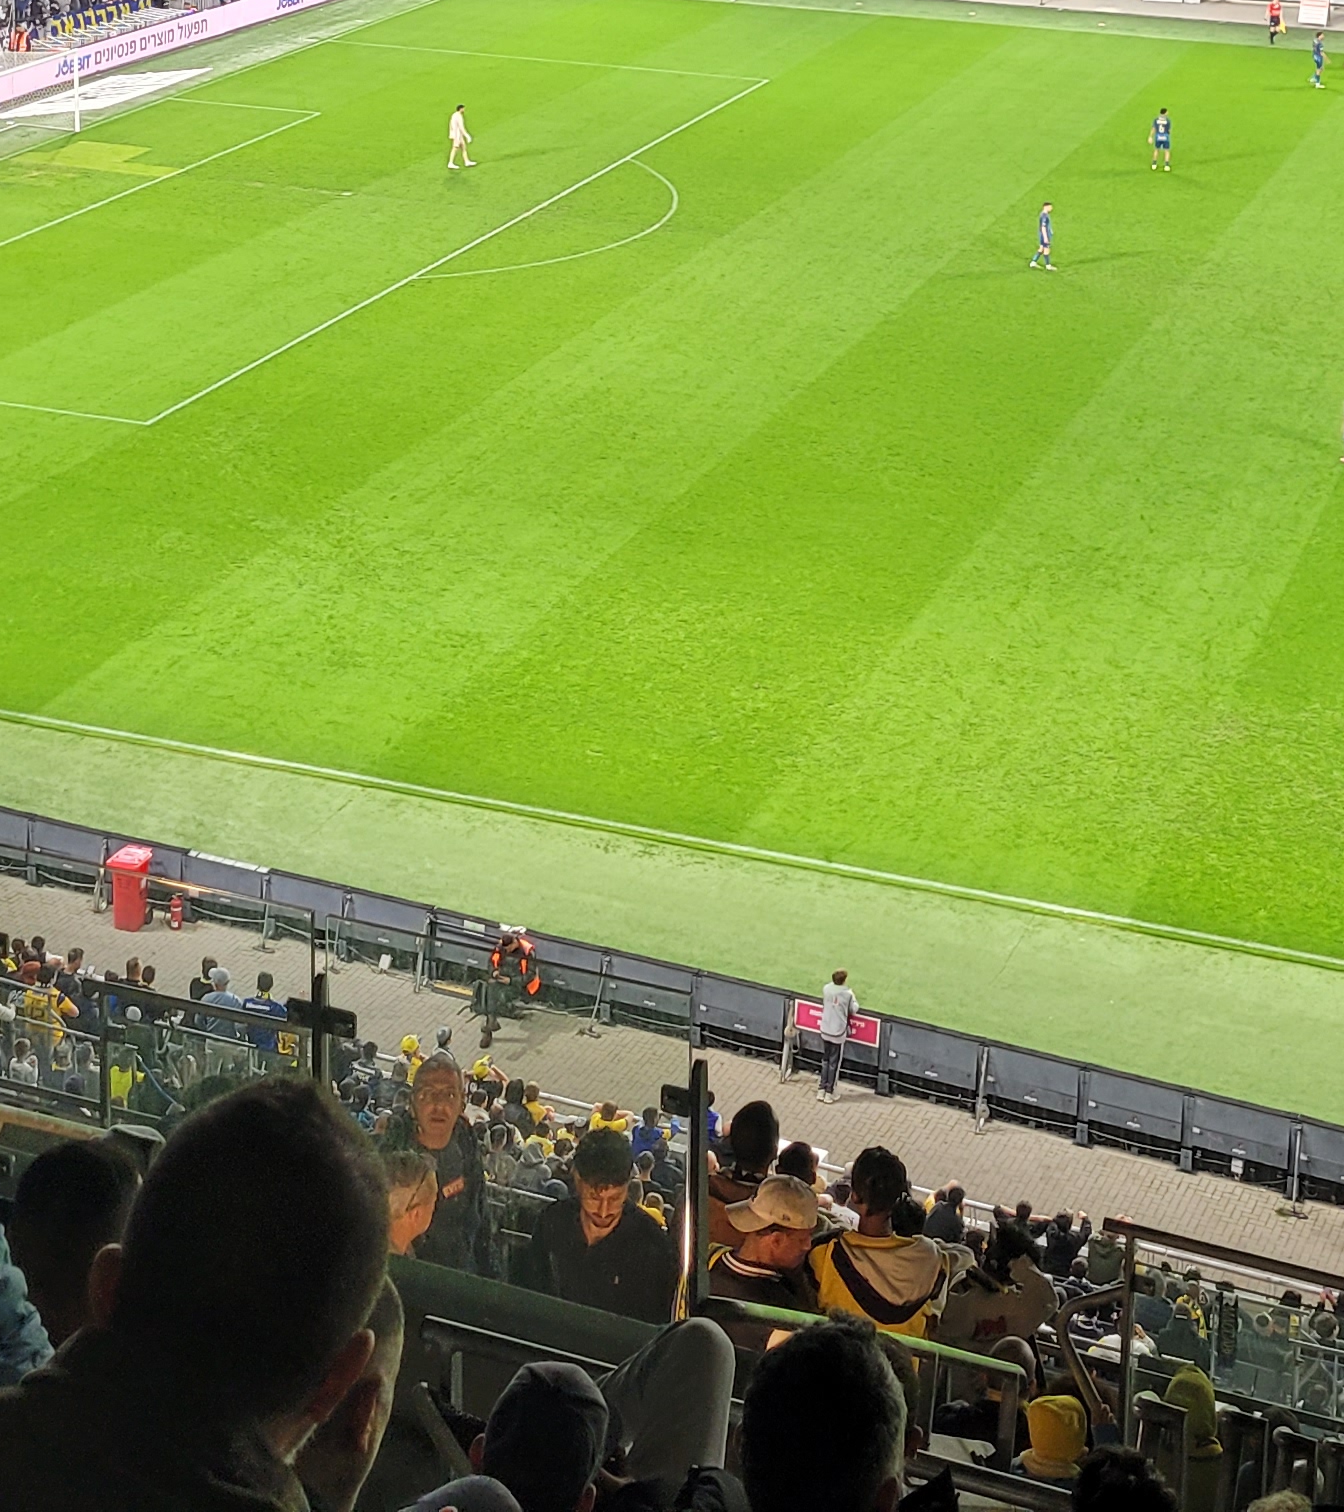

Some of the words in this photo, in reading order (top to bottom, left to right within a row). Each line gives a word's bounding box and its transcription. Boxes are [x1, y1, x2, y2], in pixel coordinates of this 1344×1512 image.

[140, 29, 174, 52] מוצרים
[177, 18, 208, 41] תפעול
[94, 40, 137, 66] פנסיונים
